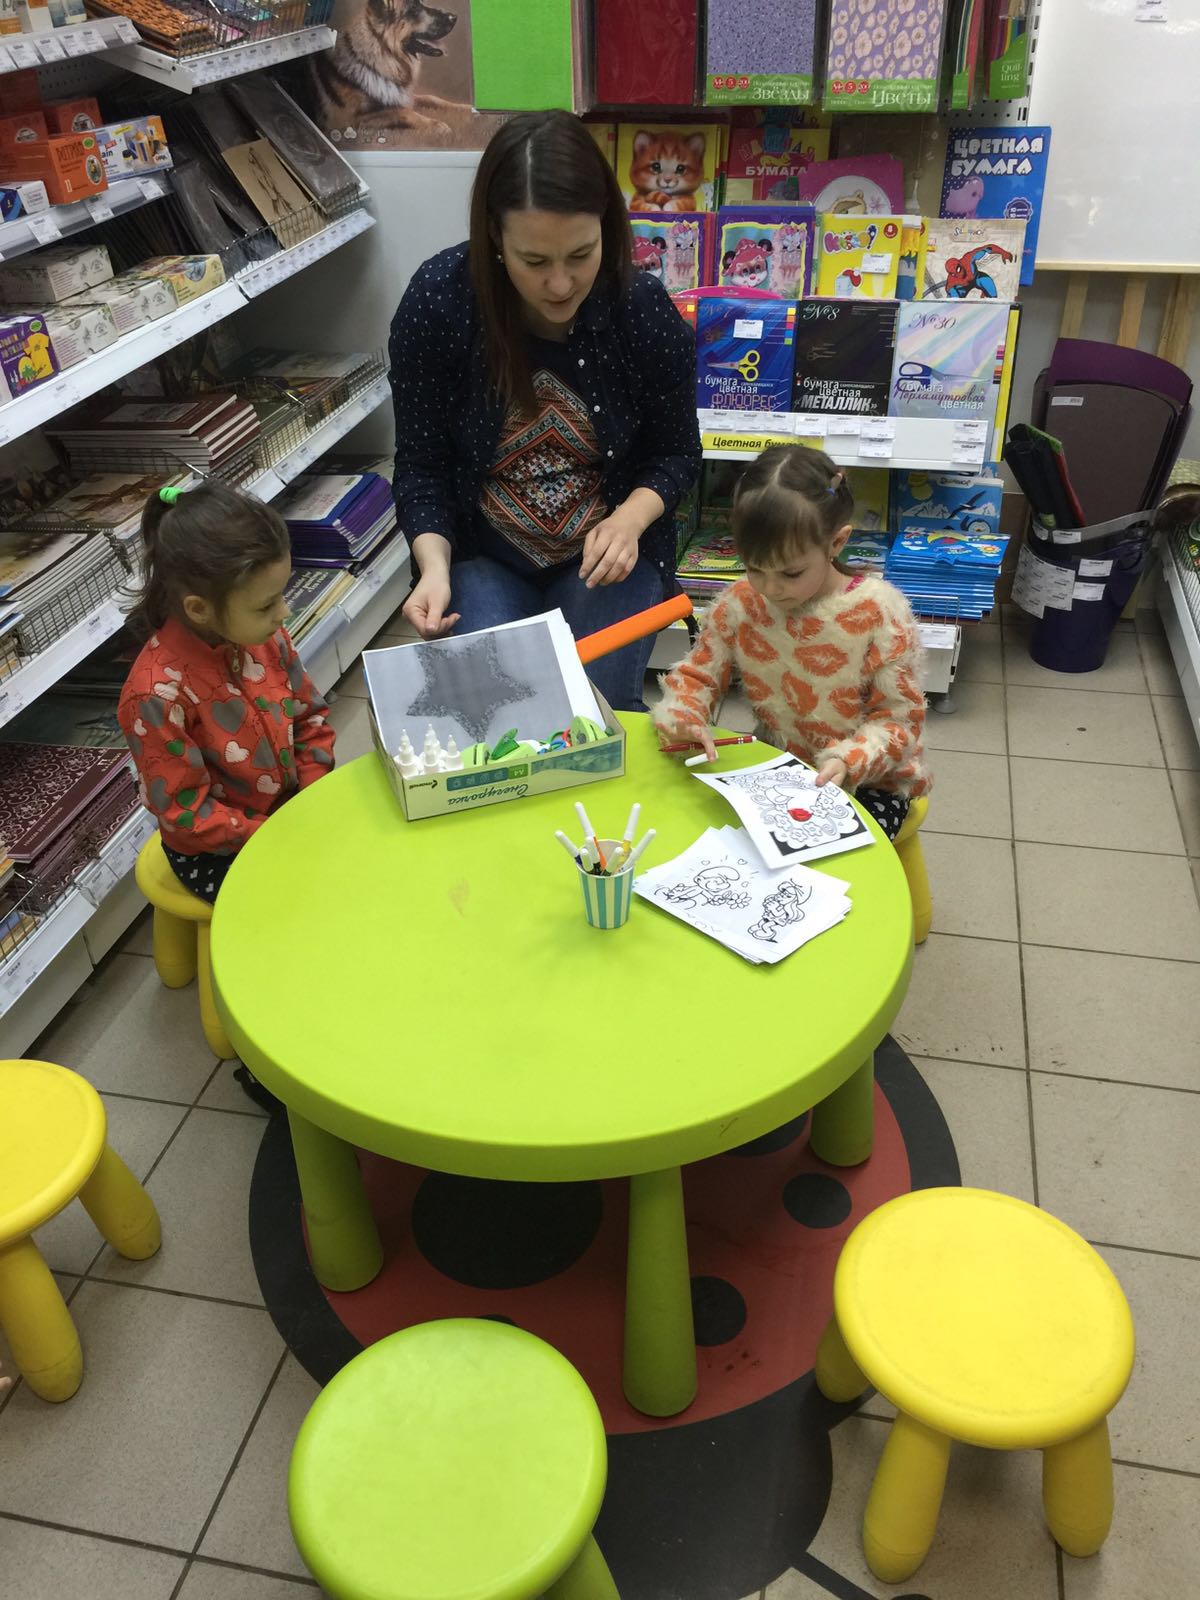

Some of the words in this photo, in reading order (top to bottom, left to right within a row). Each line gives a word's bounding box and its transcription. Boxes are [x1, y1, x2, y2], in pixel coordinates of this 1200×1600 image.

[752, 86, 810, 100] Звёзды
[872, 90, 931, 107] Цветы
[954, 137, 1044, 158] ЦВЕТНАЯ
[951, 158, 1033, 176] БУМАГА
[705, 374, 738, 387] бумага
[803, 377, 839, 390] бумага
[719, 385, 758, 394] цветная
[819, 387, 861, 398] цветная
[906, 382, 943, 393] бумага
[940, 400, 984, 410] цветная
[713, 437, 762, 448] Цветная
[447, 784, 528, 805] Снегурочка
